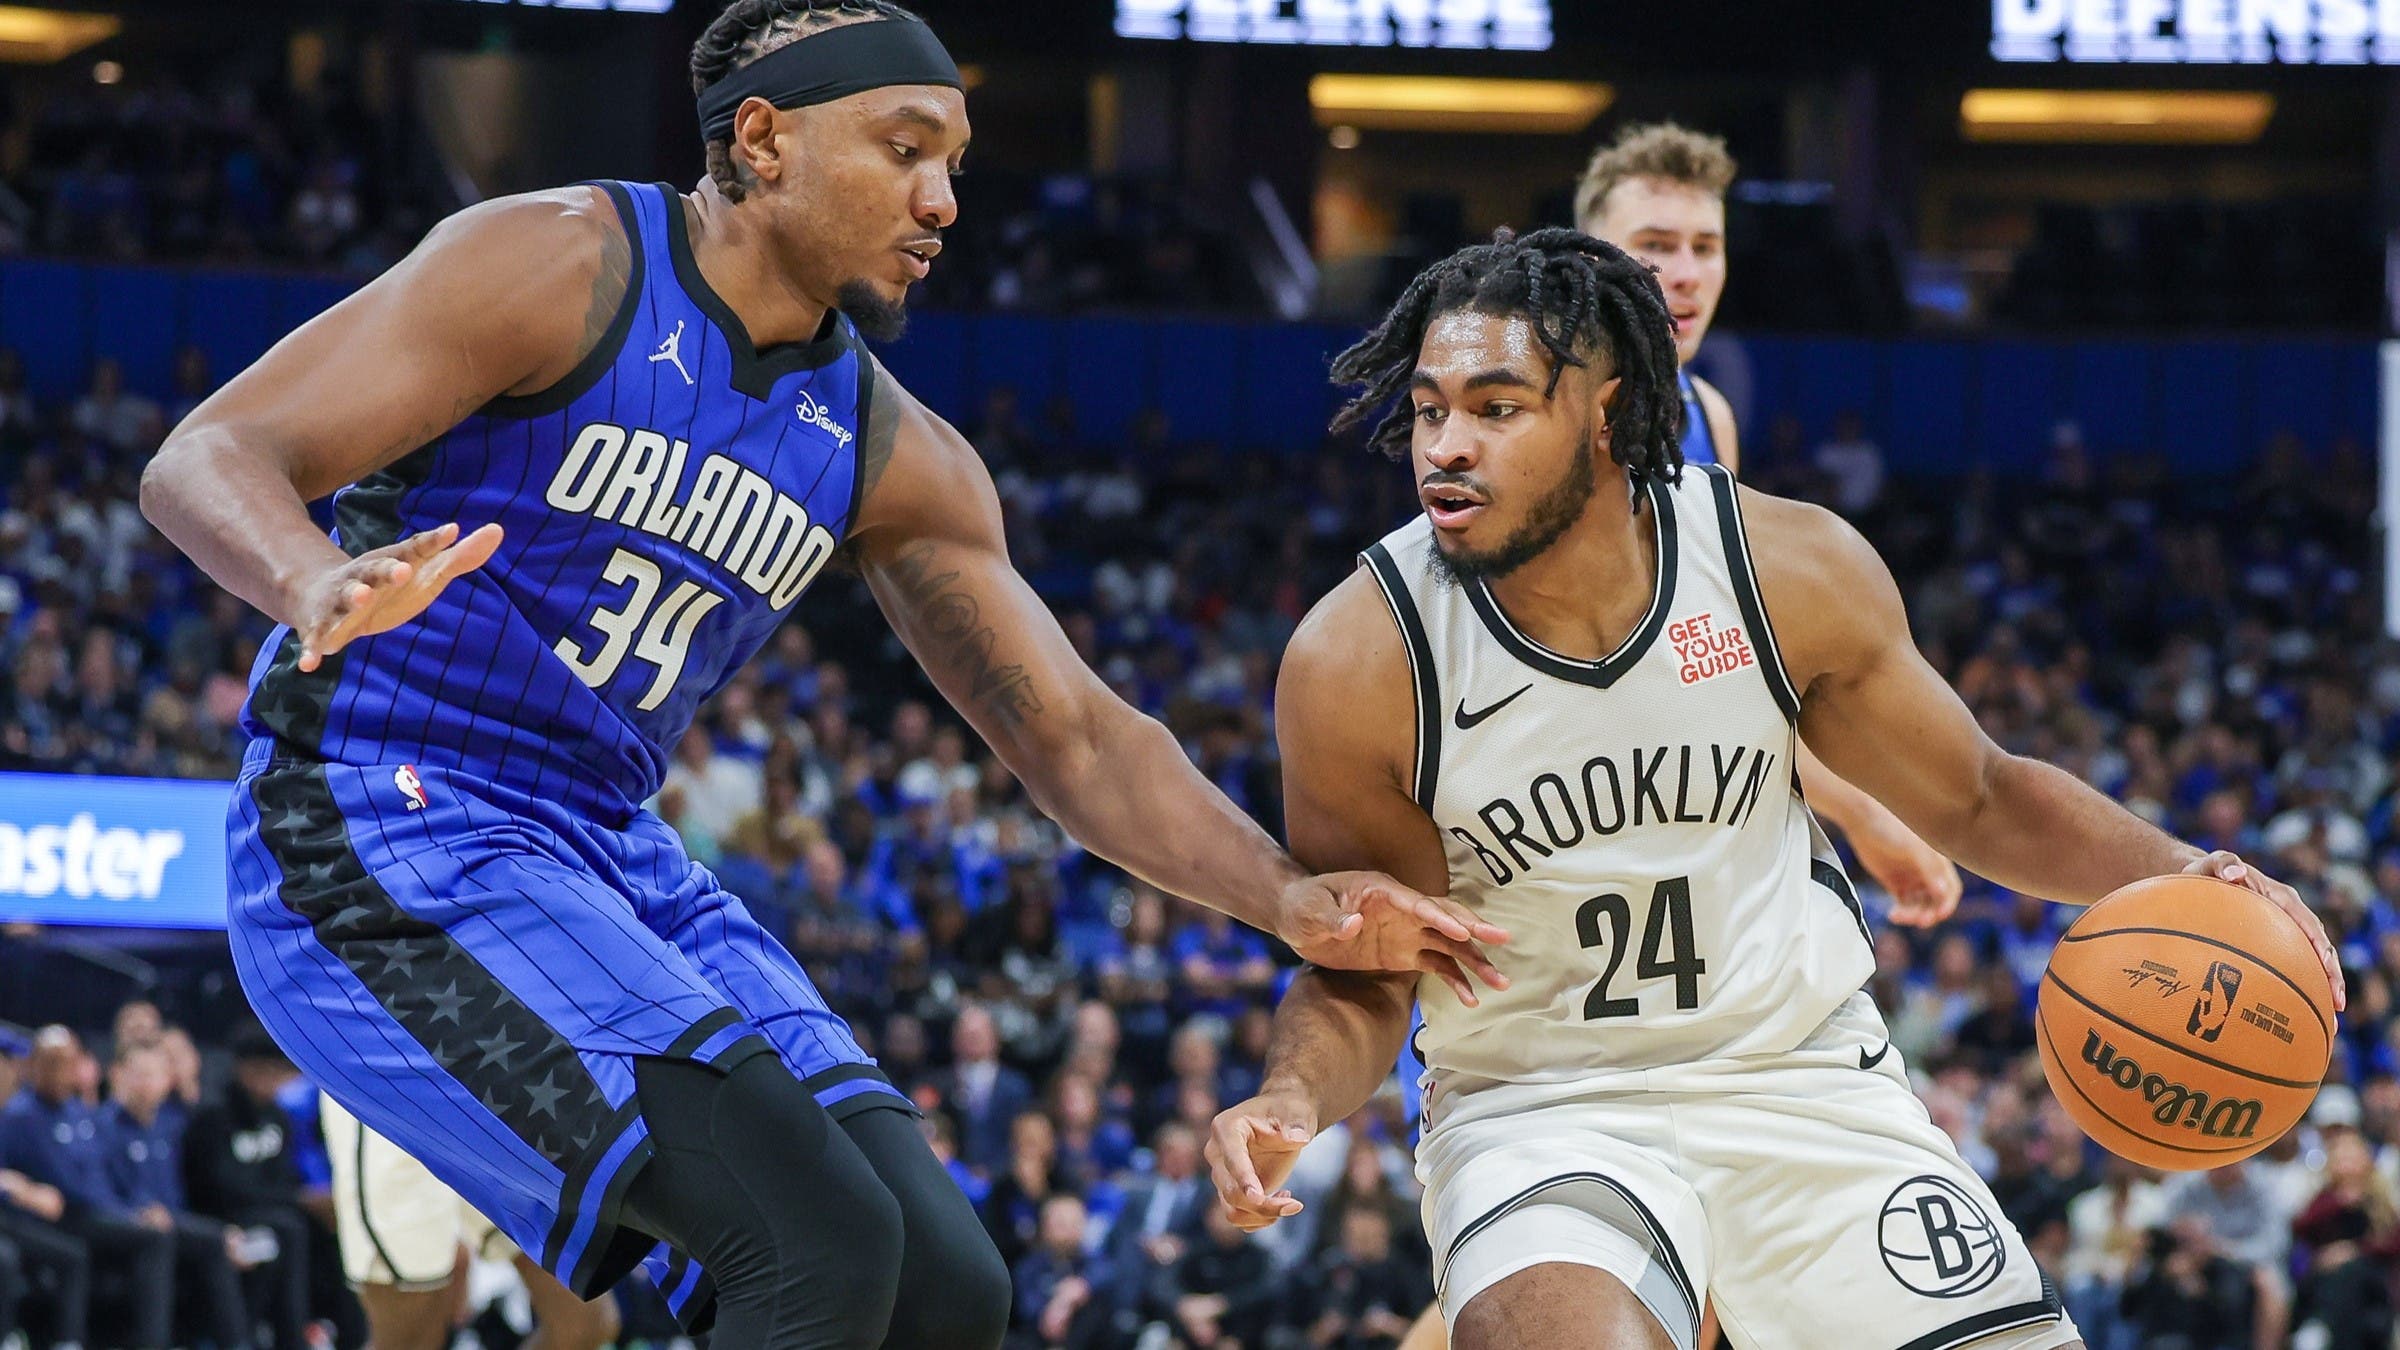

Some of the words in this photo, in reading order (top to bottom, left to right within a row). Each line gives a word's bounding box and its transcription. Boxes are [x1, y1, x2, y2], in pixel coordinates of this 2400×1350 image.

[546, 423, 835, 611] ORLANDO
[553, 547, 725, 712] 34
[1668, 613, 1712, 644] GET
[1673, 627, 1744, 663] YOUR
[1680, 645, 1754, 685] GUIDE
[1450, 743, 1775, 887] BROOKLYN
[1575, 875, 1706, 1021] 24
[2081, 1027, 2265, 1138] Wilson
[1915, 1194, 1973, 1280] B
